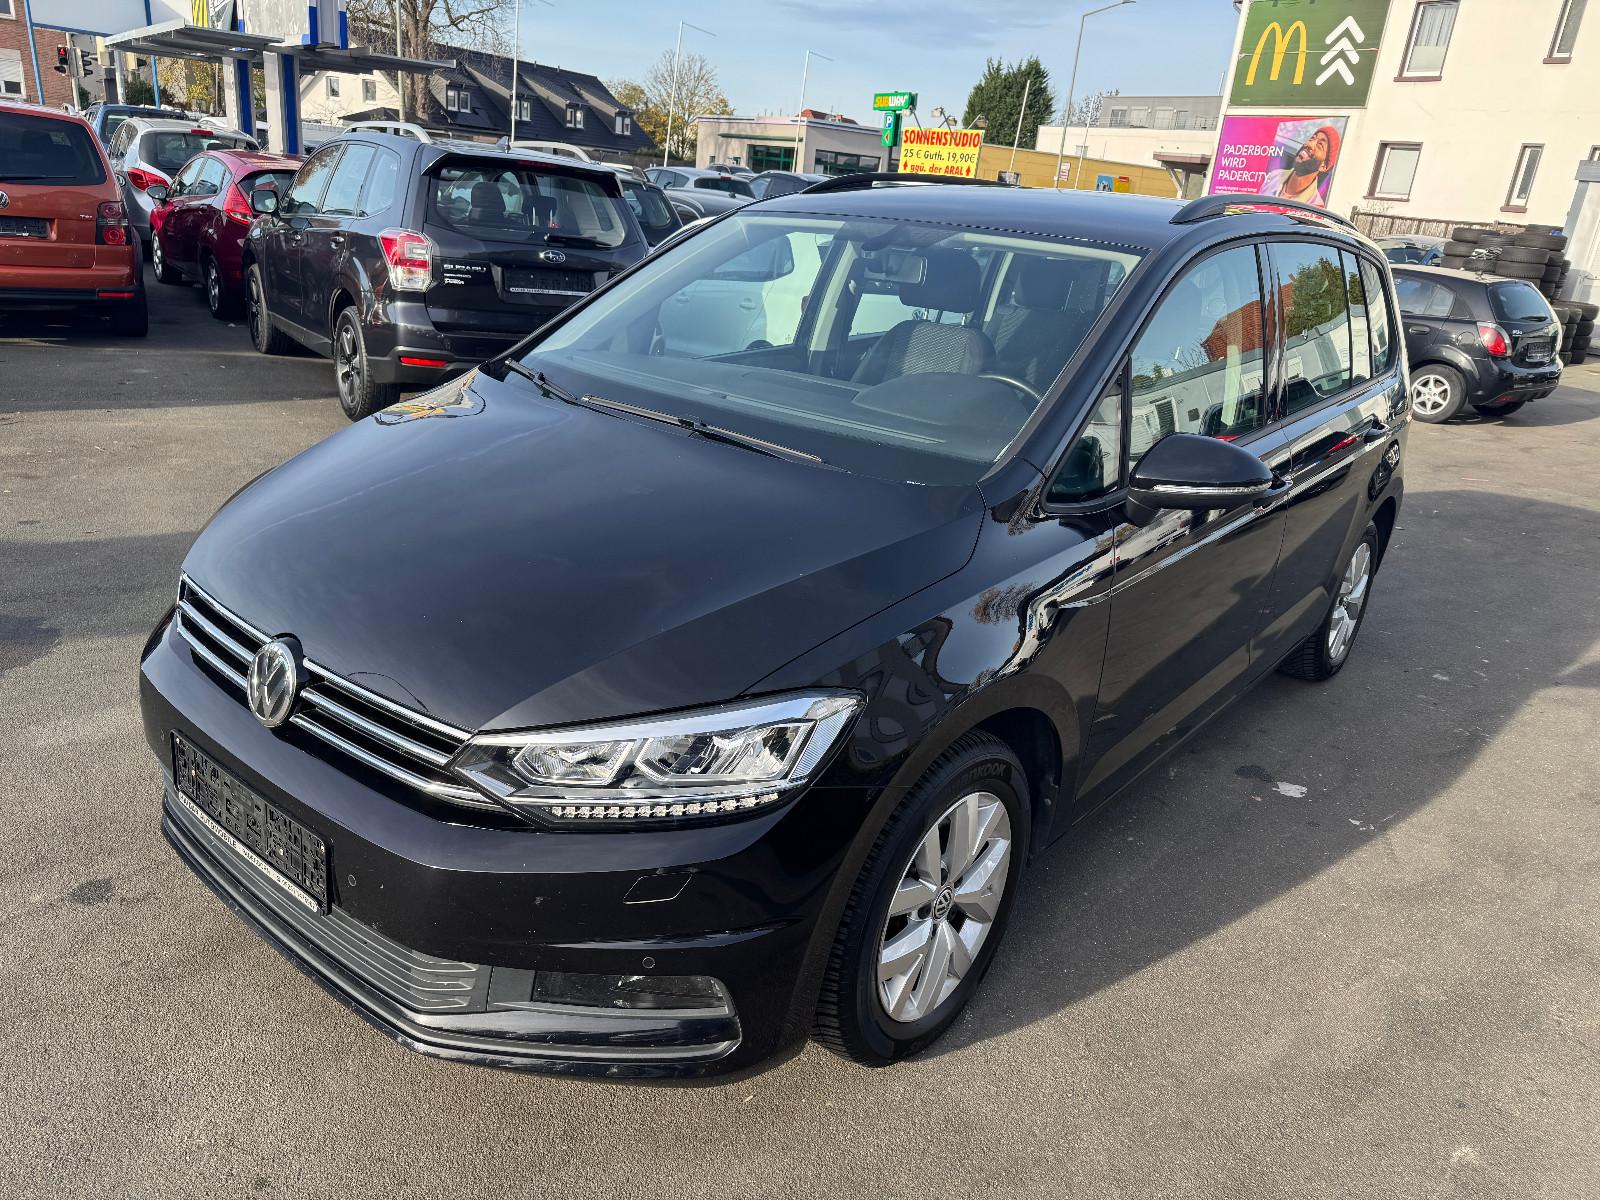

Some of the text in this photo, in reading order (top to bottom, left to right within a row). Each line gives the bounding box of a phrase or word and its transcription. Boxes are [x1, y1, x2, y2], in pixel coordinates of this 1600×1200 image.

[875, 95, 907, 107] SUBWAY
[886, 115, 892, 128] P
[903, 129, 981, 148] SONNENSTUDIO
[903, 148, 976, 164] 25 € Guth. 19,90€
[1223, 144, 1284, 157] PADERBORN
[1221, 157, 1247, 168] WIRD
[928, 163, 942, 173] der
[944, 165, 964, 176] ARAL
[443, 264, 487, 273] SUBARU
